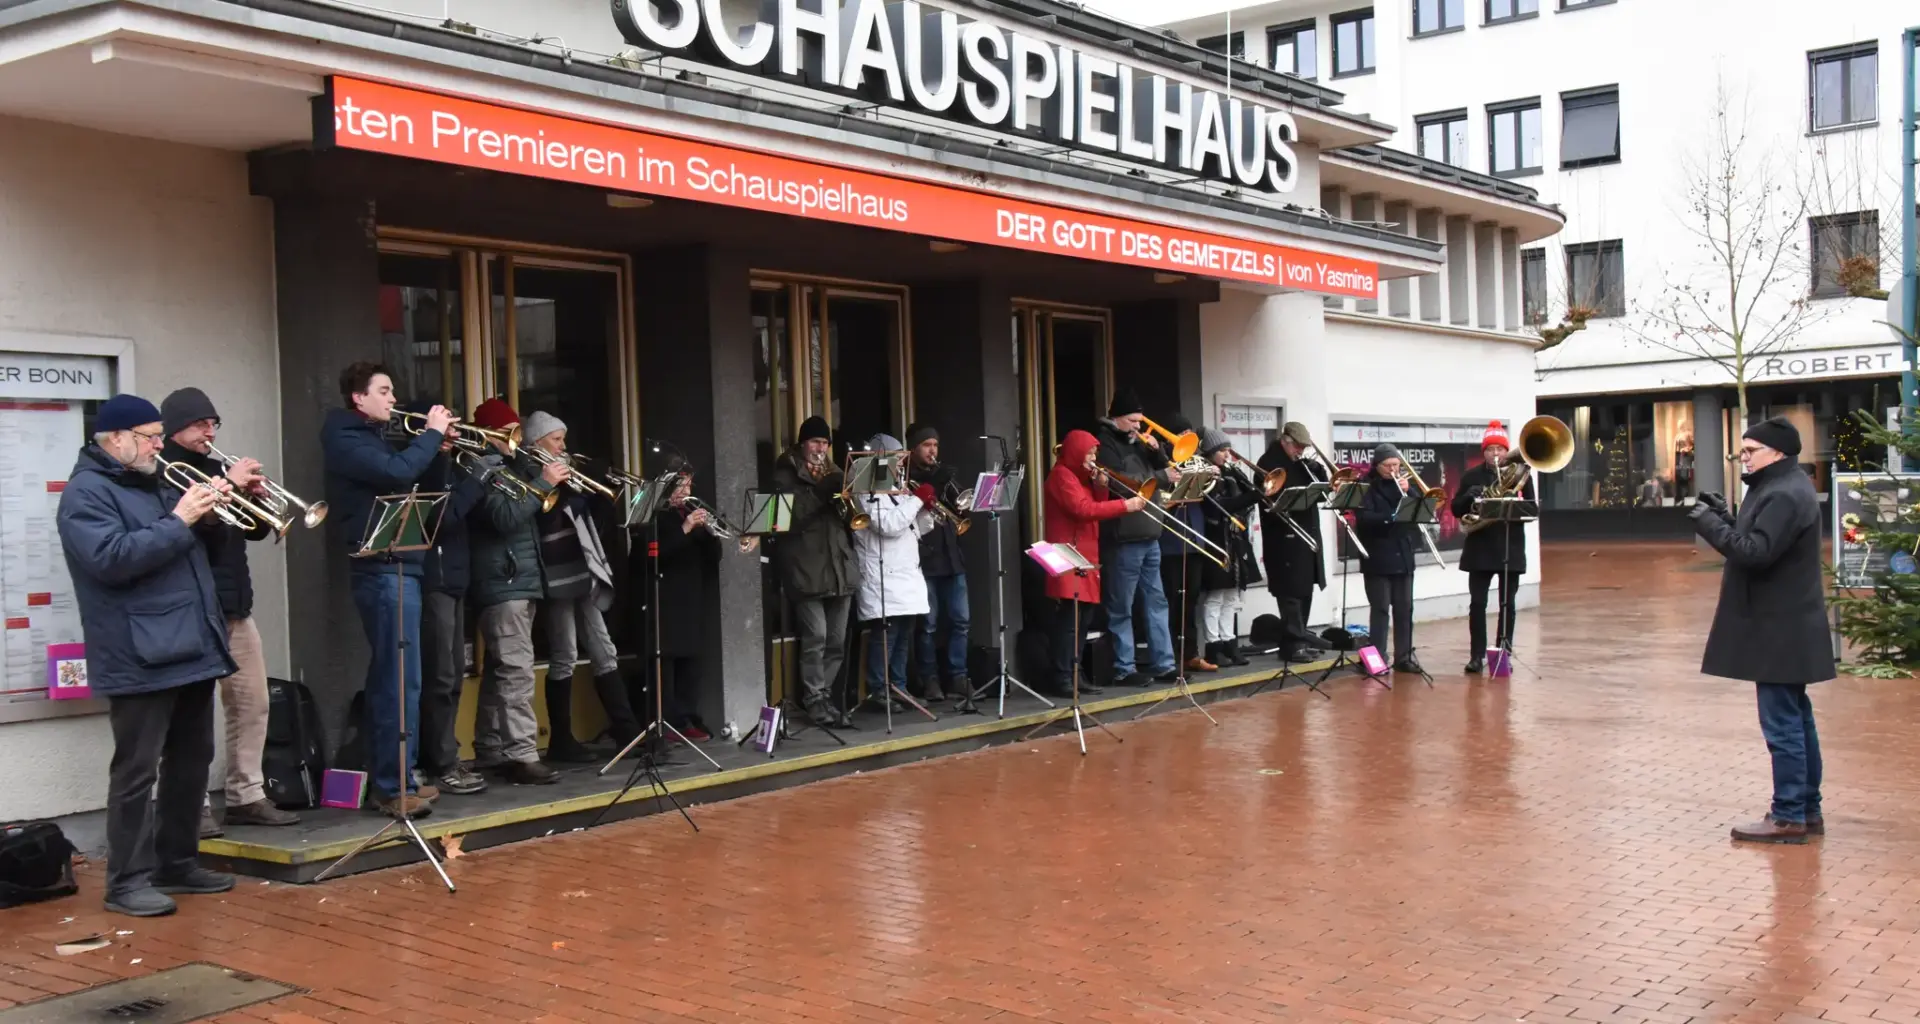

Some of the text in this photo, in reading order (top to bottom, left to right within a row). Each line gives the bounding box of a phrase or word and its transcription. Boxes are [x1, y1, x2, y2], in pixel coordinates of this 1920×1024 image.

[432, 110, 626, 179] Premieren
[638, 147, 676, 186] im
[686, 156, 909, 222] Schauspielhaus
[996, 209, 1374, 292] DER GOTT DES GEMETZELS von Yasmina
[29, 367, 93, 385] BONN
[1766, 353, 1893, 376] ROBERT
